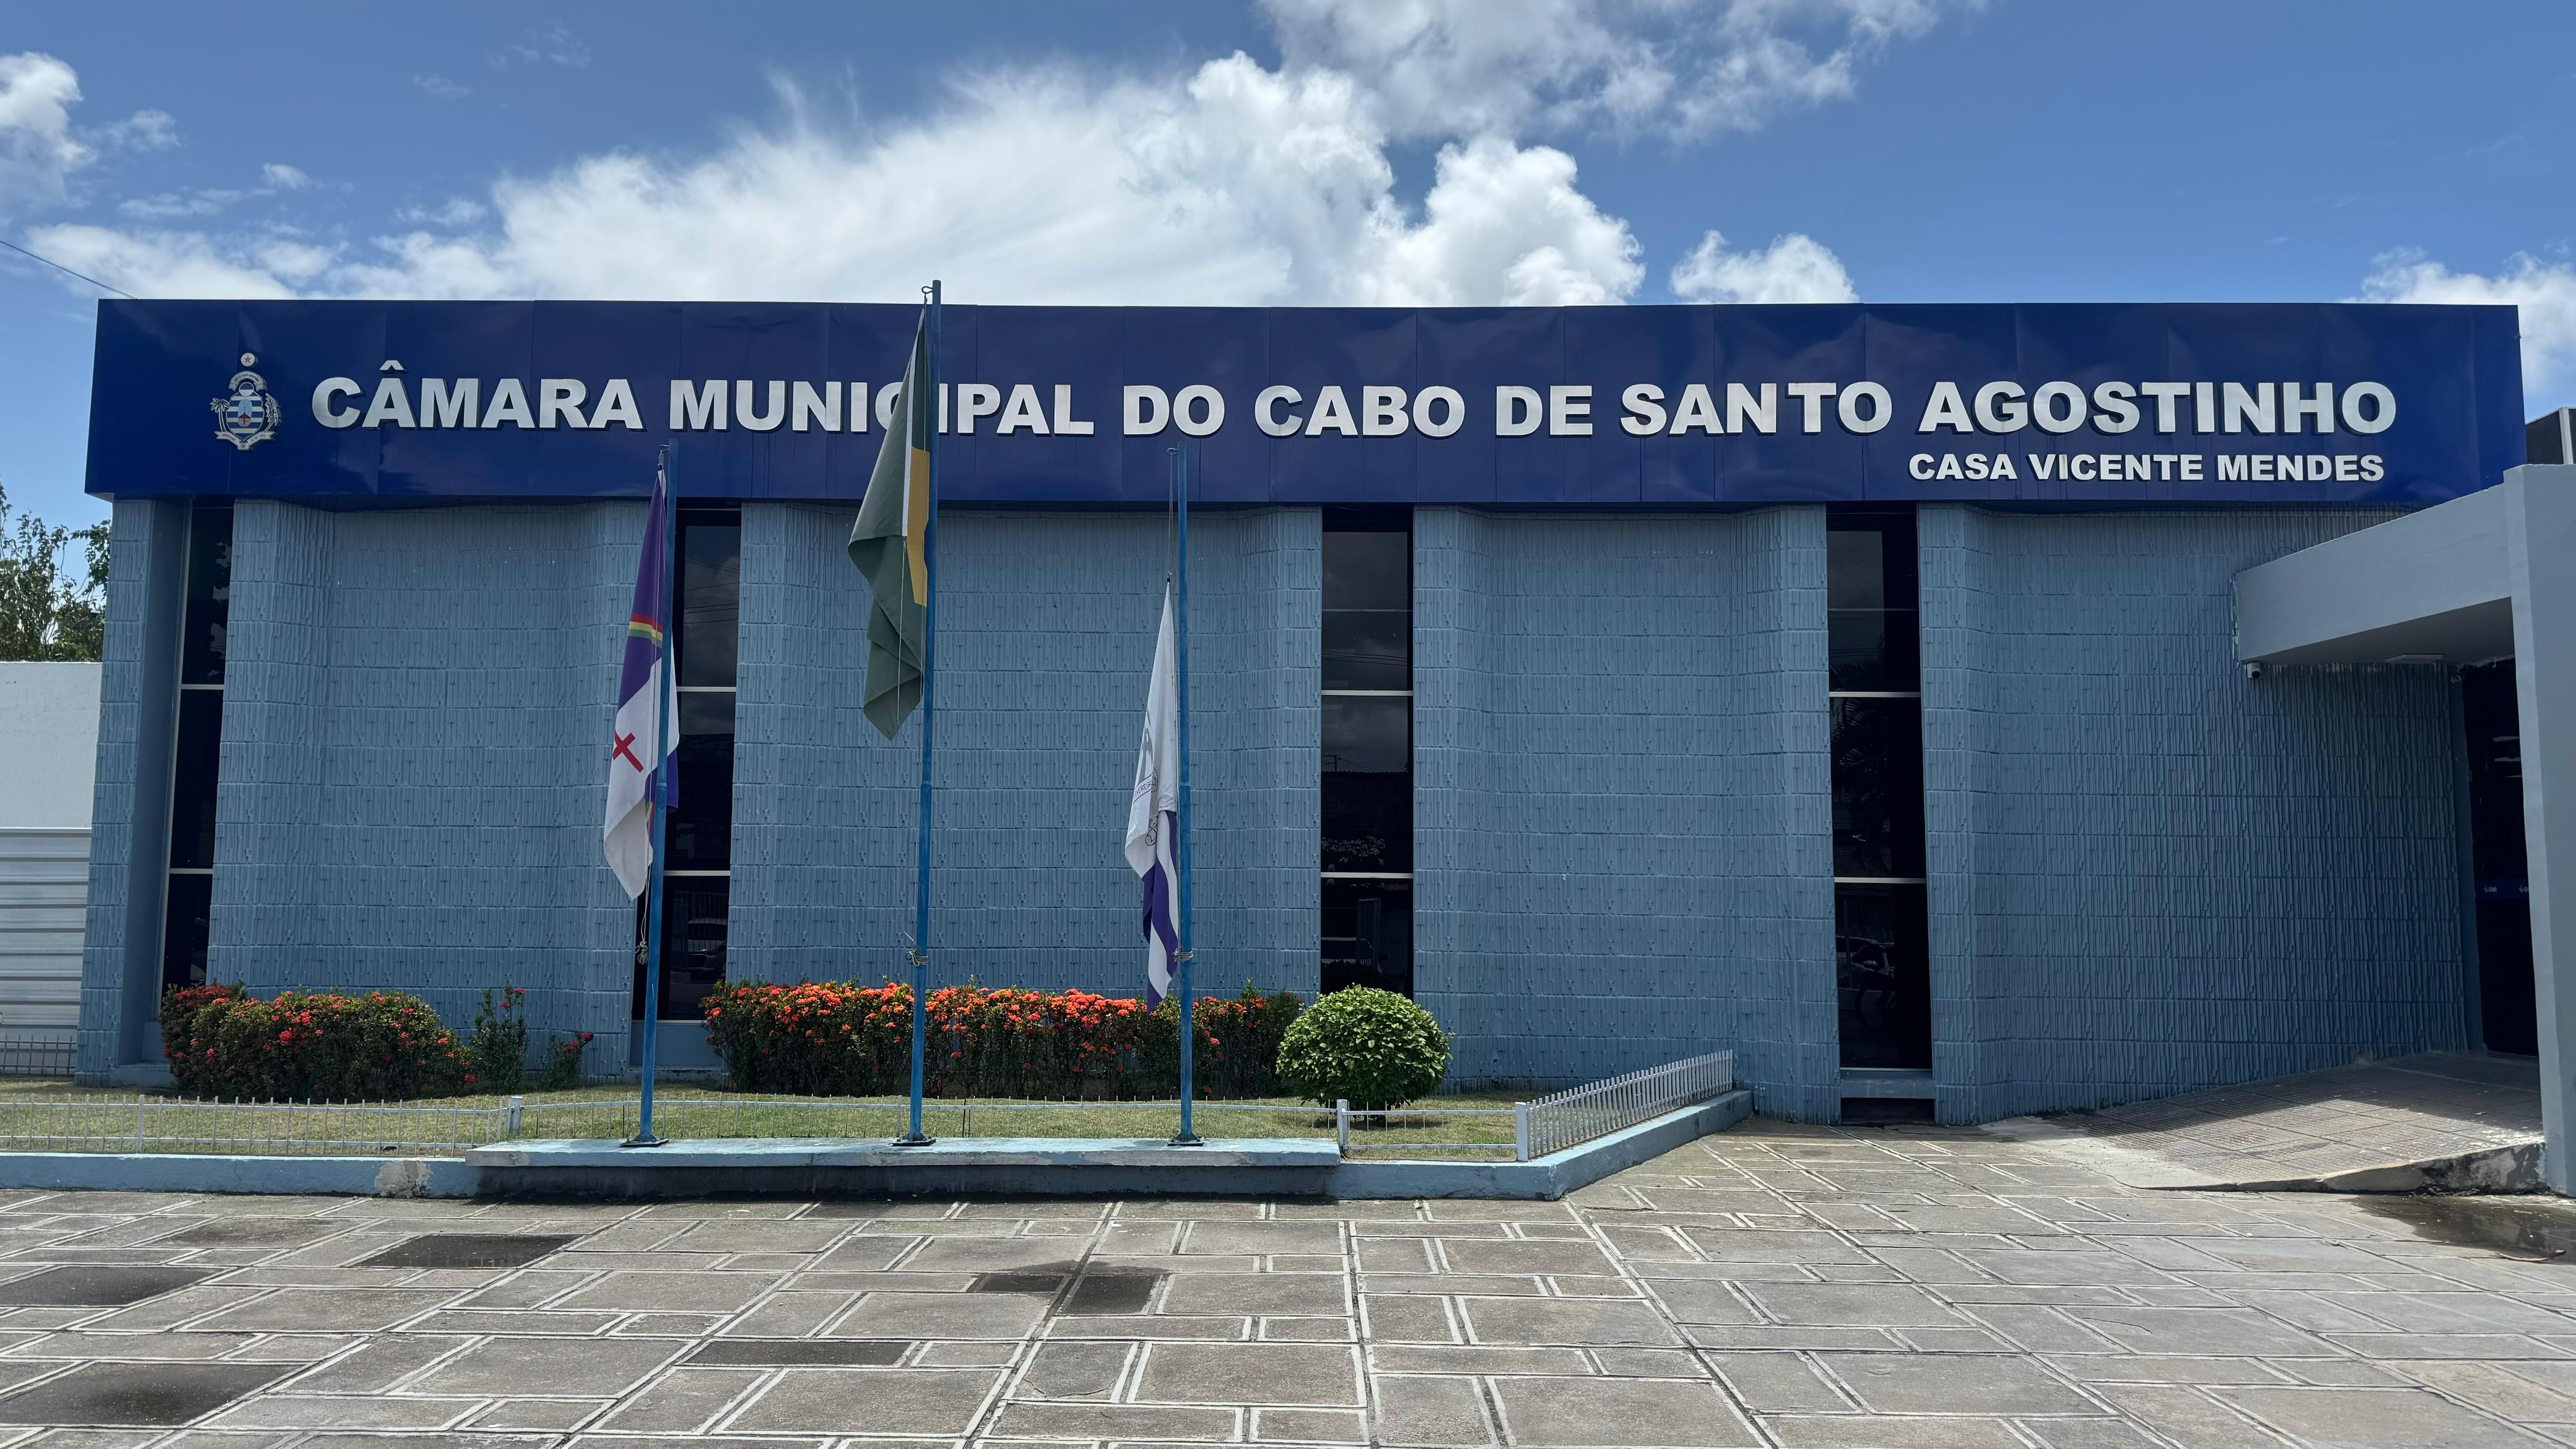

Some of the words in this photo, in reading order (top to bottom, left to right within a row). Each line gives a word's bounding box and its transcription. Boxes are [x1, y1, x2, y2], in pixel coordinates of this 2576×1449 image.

[312, 359, 644, 429] CÂMARA
[1123, 385, 1225, 436] DO
[1254, 385, 1465, 437] CABO
[1495, 385, 1593, 436] DE
[1619, 381, 1892, 436] SANTO
[1918, 380, 2396, 434] AGOSTINHO
[1908, 453, 2018, 481] CASA
[2028, 454, 2204, 481] VICENTE
[2217, 455, 2385, 481] MENDES
